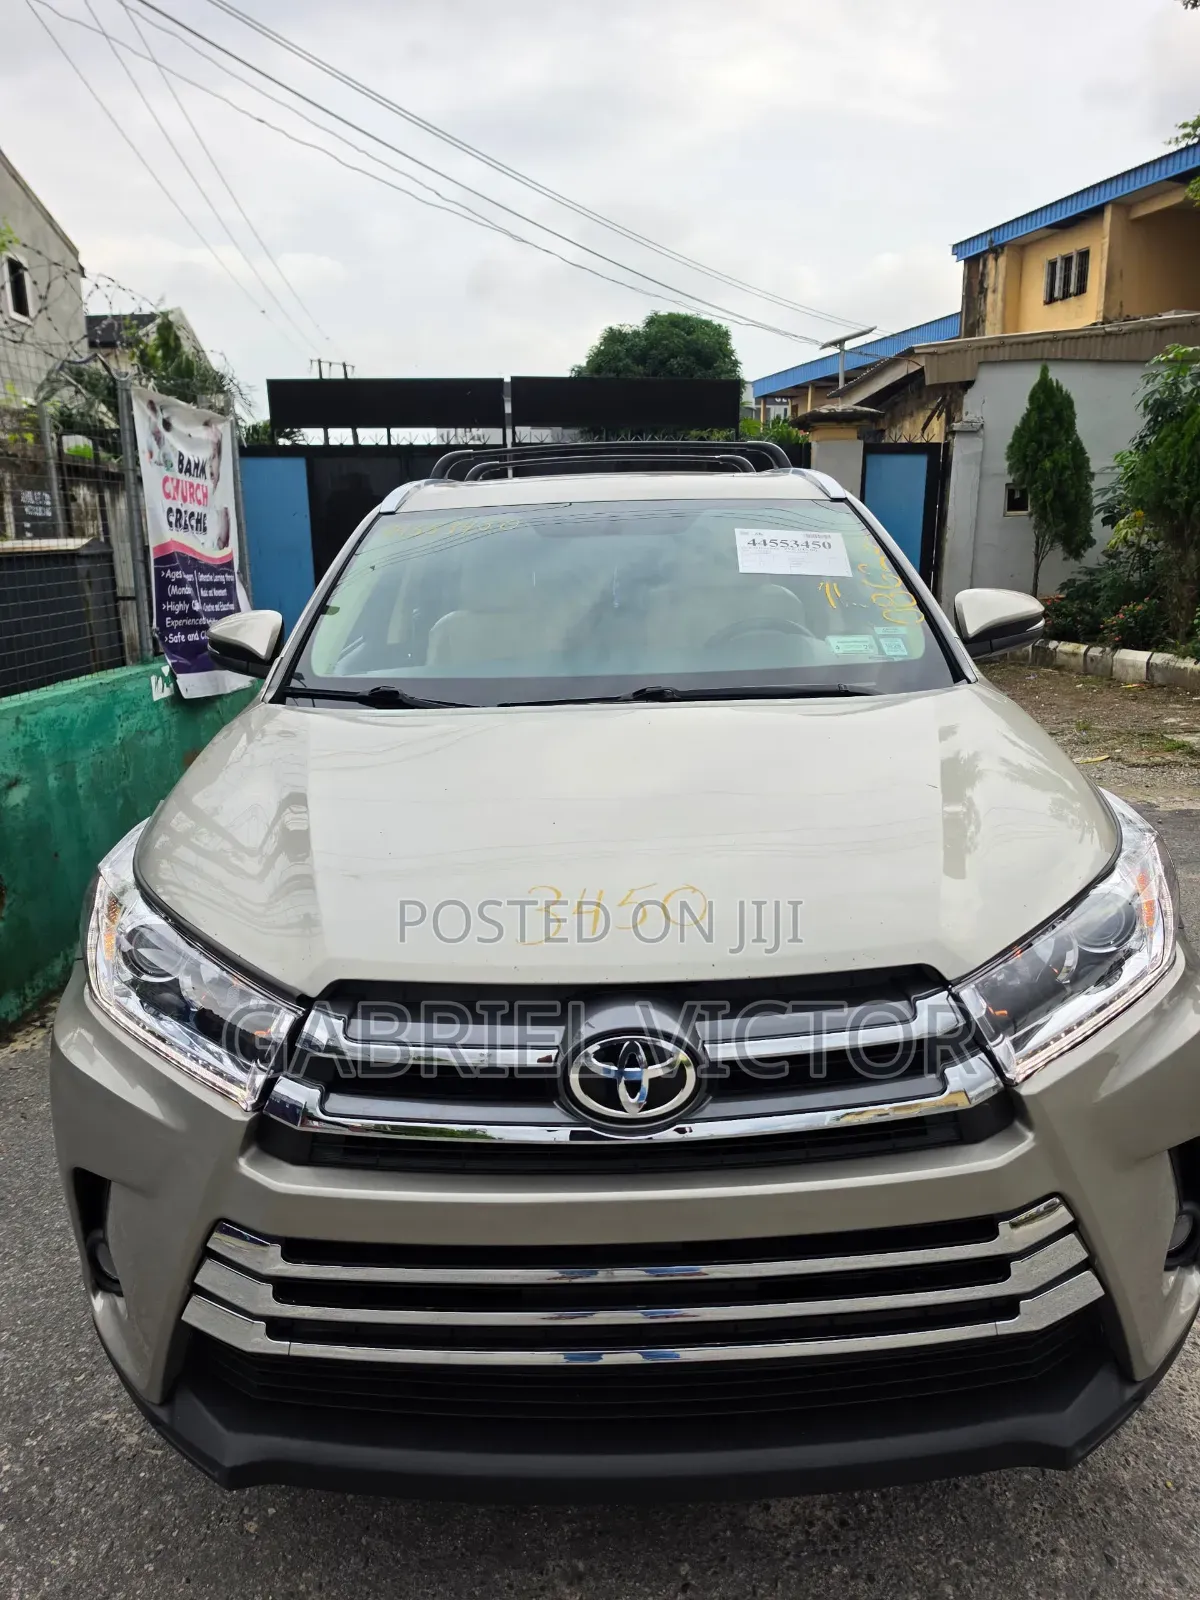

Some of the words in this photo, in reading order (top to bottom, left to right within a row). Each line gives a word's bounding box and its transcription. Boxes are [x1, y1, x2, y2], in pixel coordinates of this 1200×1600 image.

[162, 475, 209, 507] CHURCH
[747, 538, 833, 550] 44553450
[165, 568, 182, 582] Ages
[166, 601, 190, 614] Highly
[168, 631, 186, 644] Safe
[187, 630, 200, 642] and
[516, 883, 708, 946] 3450
